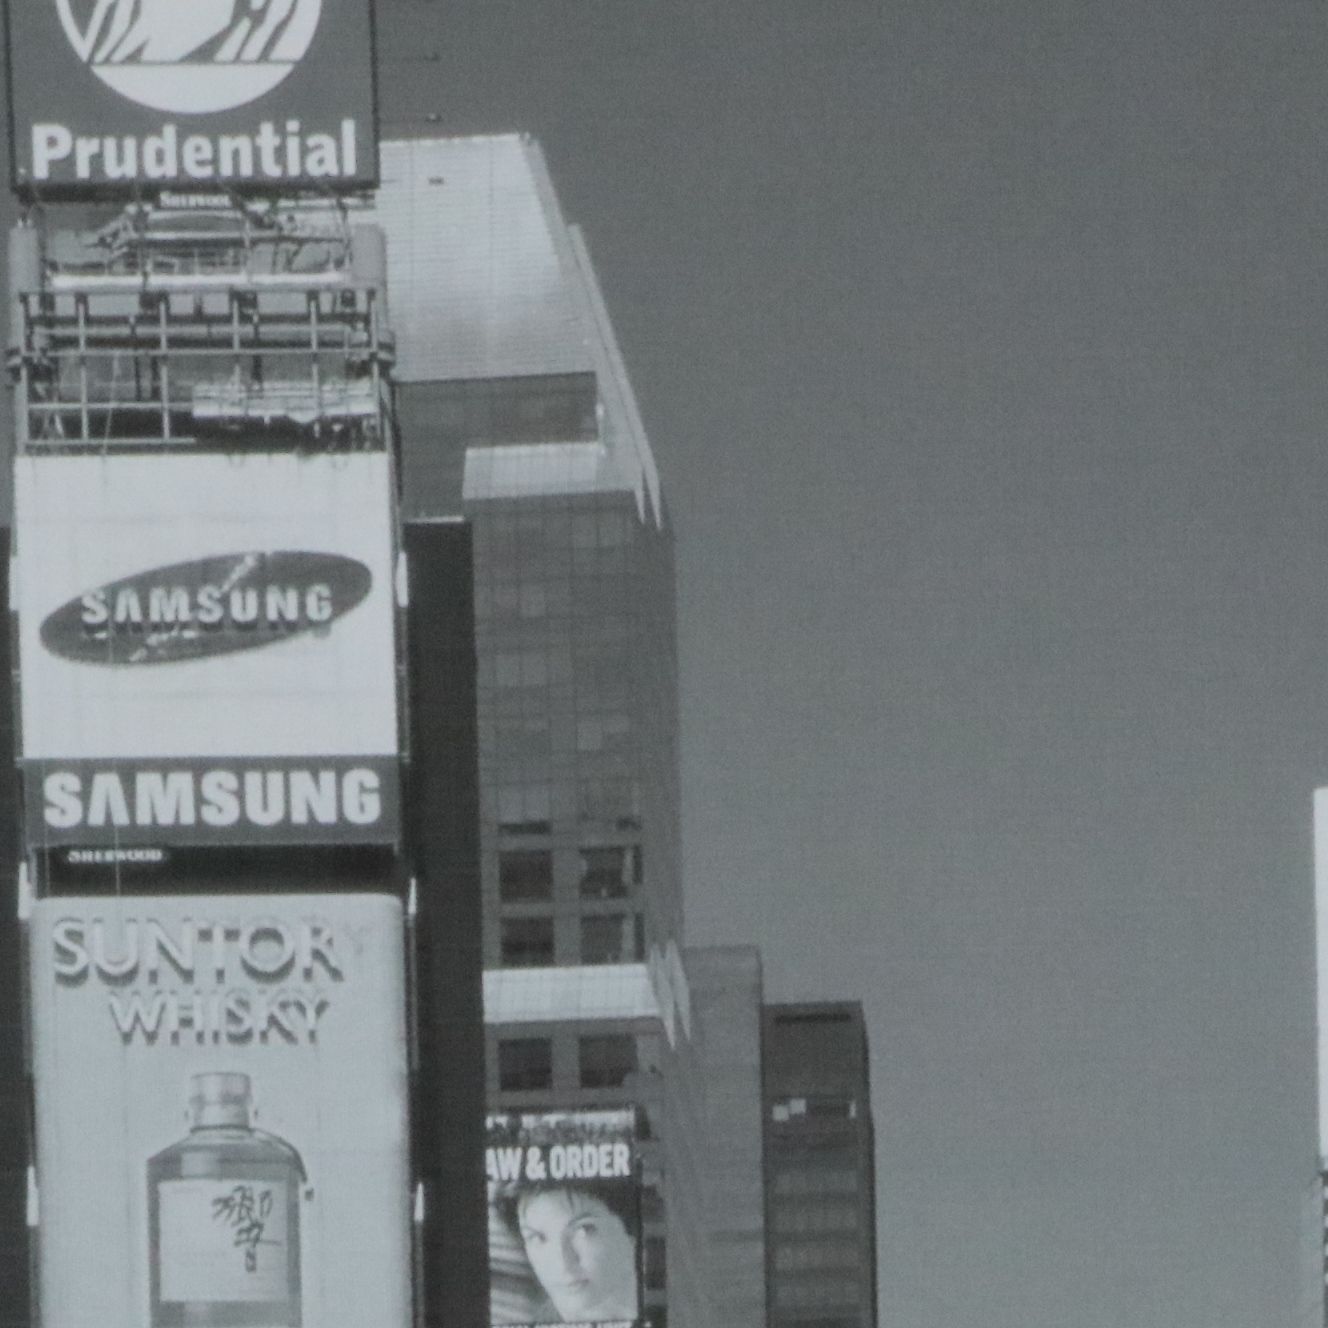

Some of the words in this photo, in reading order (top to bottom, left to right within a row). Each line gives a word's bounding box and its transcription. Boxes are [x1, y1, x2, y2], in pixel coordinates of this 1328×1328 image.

[32, 119, 357, 180] Prudential
[80, 584, 333, 625] SAMSUNG
[43, 768, 382, 829] SAMSUNG
[52, 916, 360, 988] SUNTOR
[108, 988, 332, 1047] WHISKY
[525, 1145, 547, 1181] &
[550, 1143, 632, 1180] ORDER
